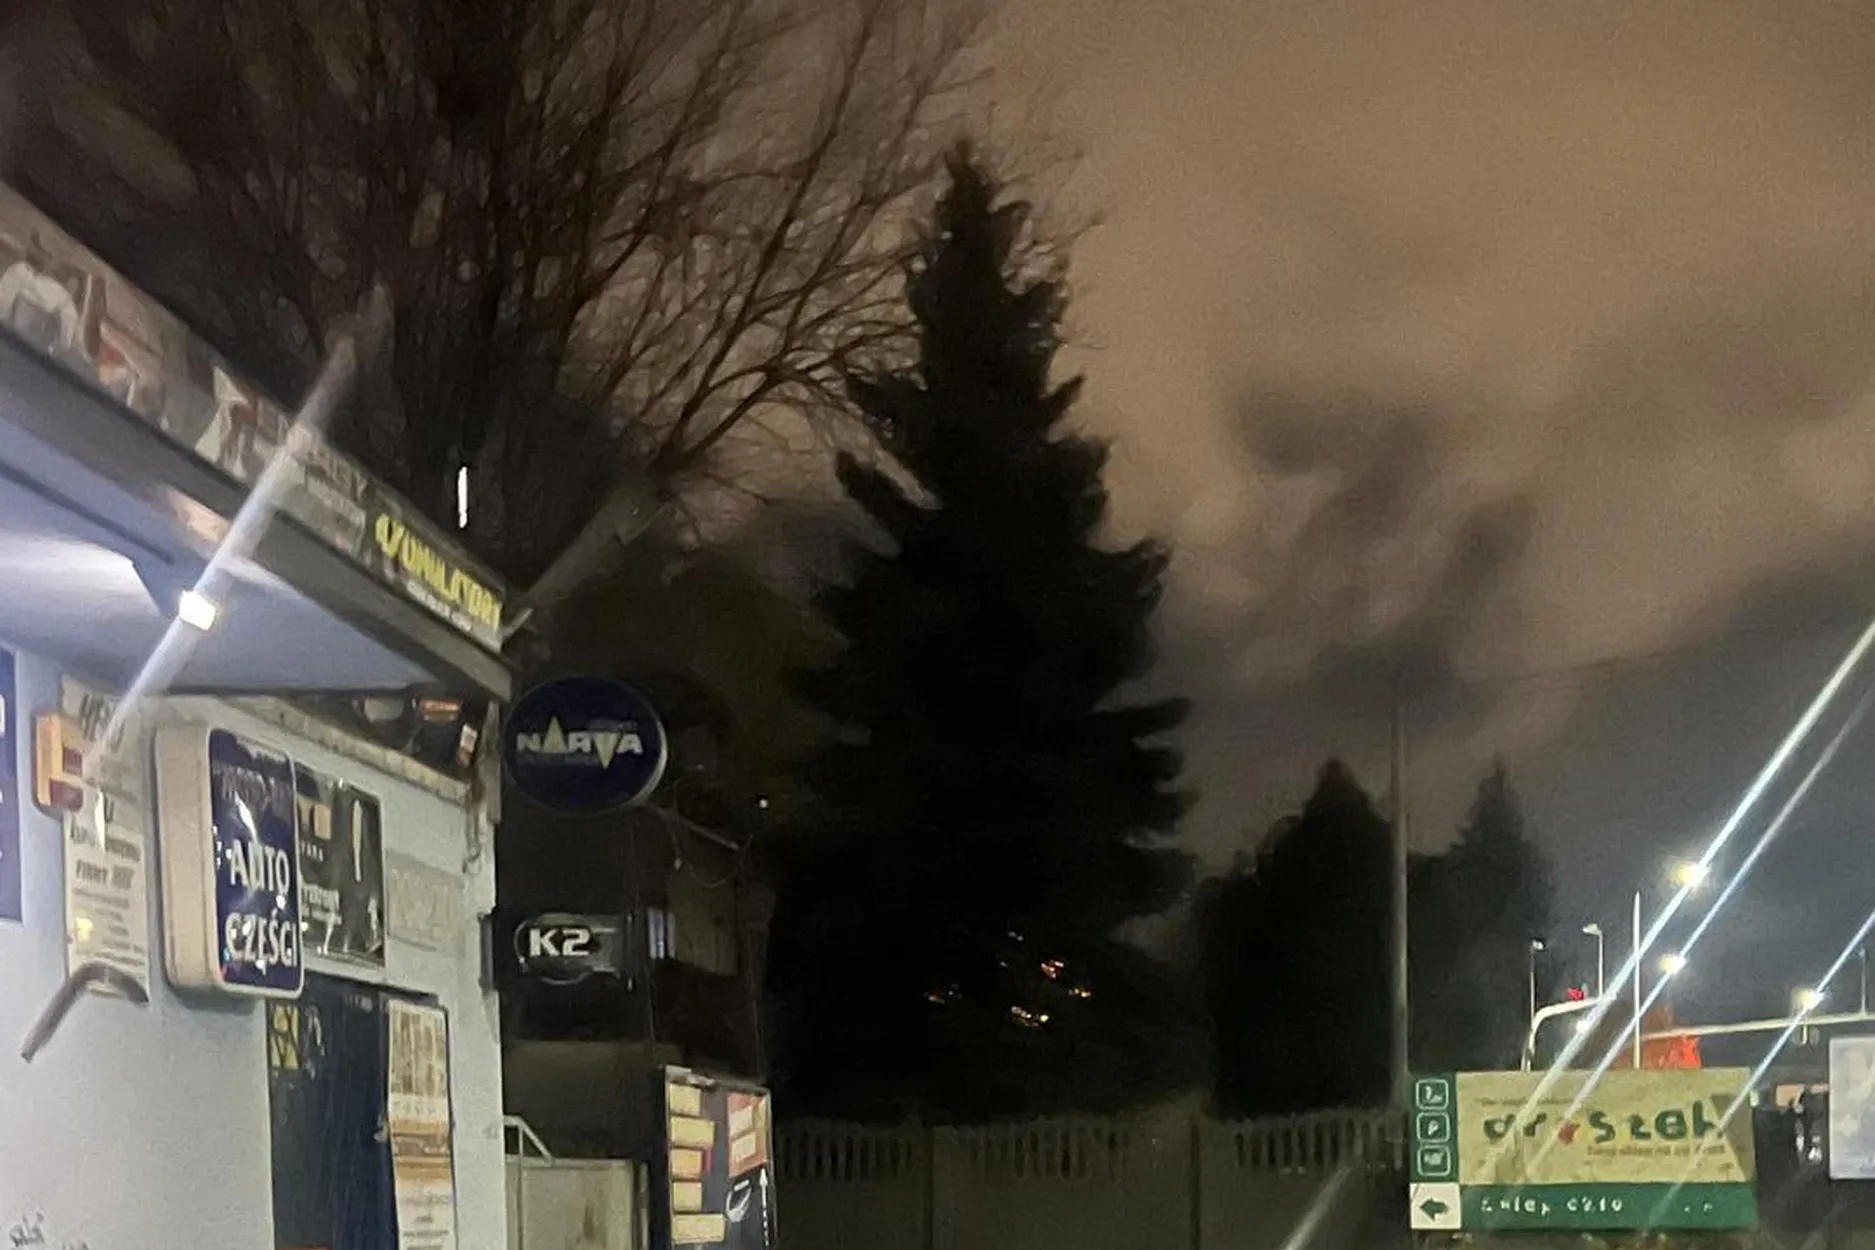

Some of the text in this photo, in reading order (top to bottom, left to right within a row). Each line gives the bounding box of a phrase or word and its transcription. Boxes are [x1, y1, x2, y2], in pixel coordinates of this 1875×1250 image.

[516, 715, 644, 769] NARVA
[230, 838, 291, 896] AUTO
[530, 928, 591, 957] K2
